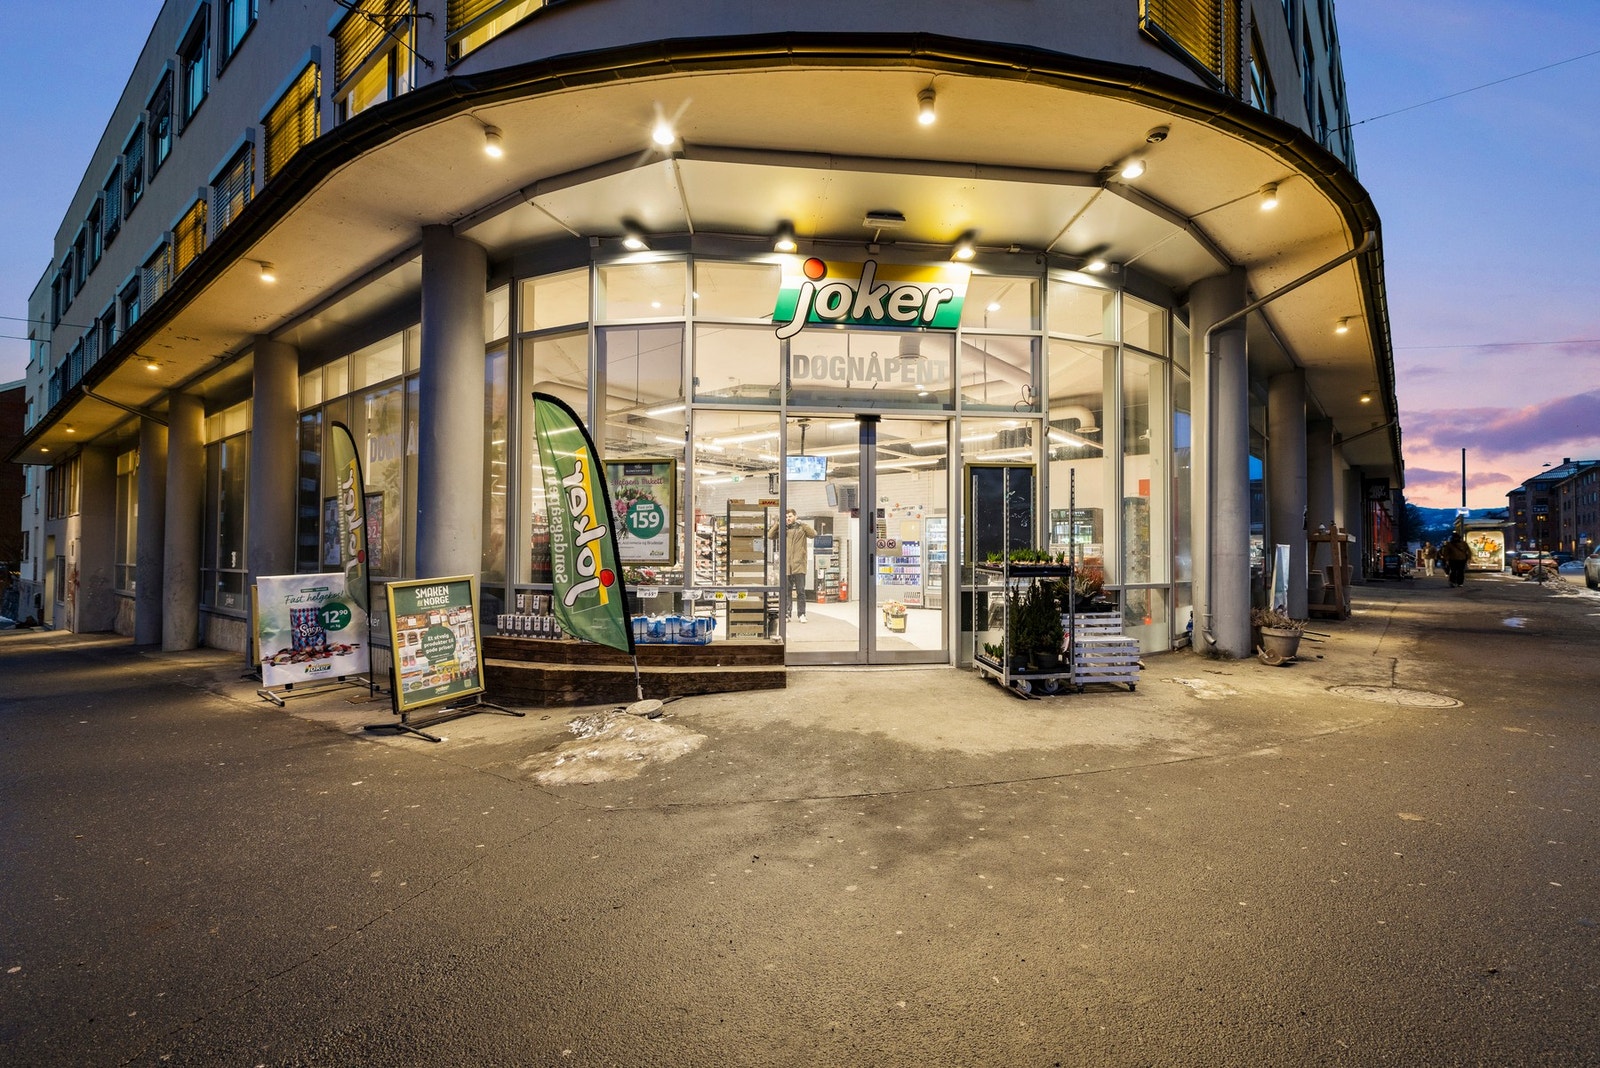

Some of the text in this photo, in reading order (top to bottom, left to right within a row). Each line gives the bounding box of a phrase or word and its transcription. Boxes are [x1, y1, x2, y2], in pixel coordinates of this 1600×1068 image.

[775, 257, 954, 339] joker
[792, 351, 948, 383] DØGNÅPENT
[629, 511, 660, 529] 159
[284, 594, 304, 605] Fast
[415, 585, 449, 599] SMAKEN
[423, 595, 450, 606] NORGE
